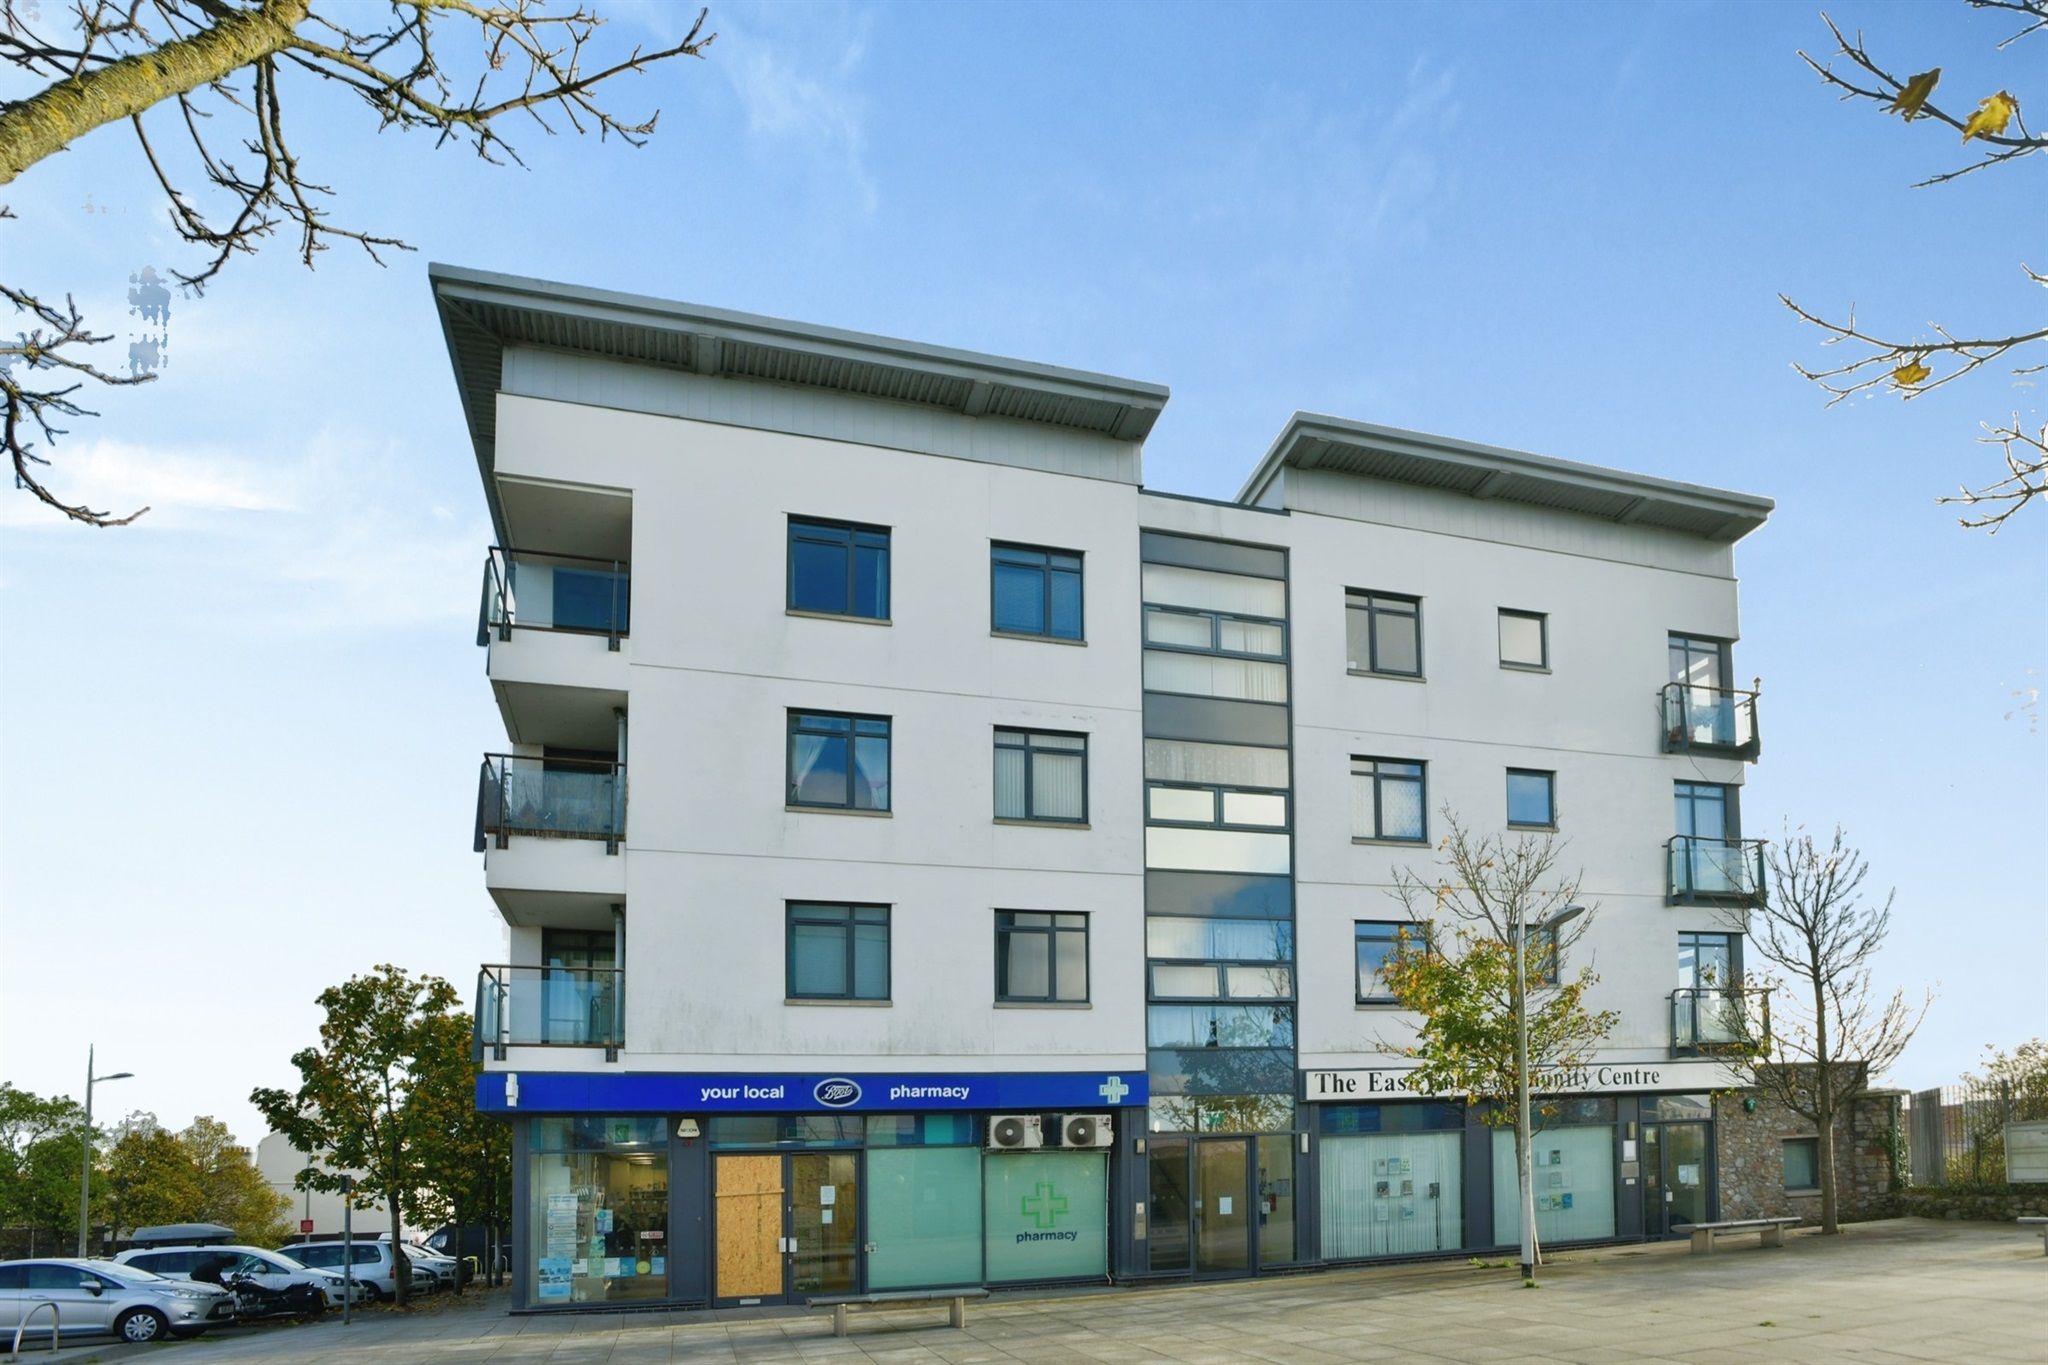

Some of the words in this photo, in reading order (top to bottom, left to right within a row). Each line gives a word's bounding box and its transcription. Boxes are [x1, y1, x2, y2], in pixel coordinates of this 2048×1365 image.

[1315, 1073, 1357, 1093] The
[1367, 1072, 1415, 1092] Eas
[1598, 1066, 1660, 1086] Centre
[701, 1087, 740, 1101] your
[744, 1085, 784, 1099] local
[890, 1084, 969, 1100] pharmacy
[1016, 1231, 1077, 1244] pharmacy
